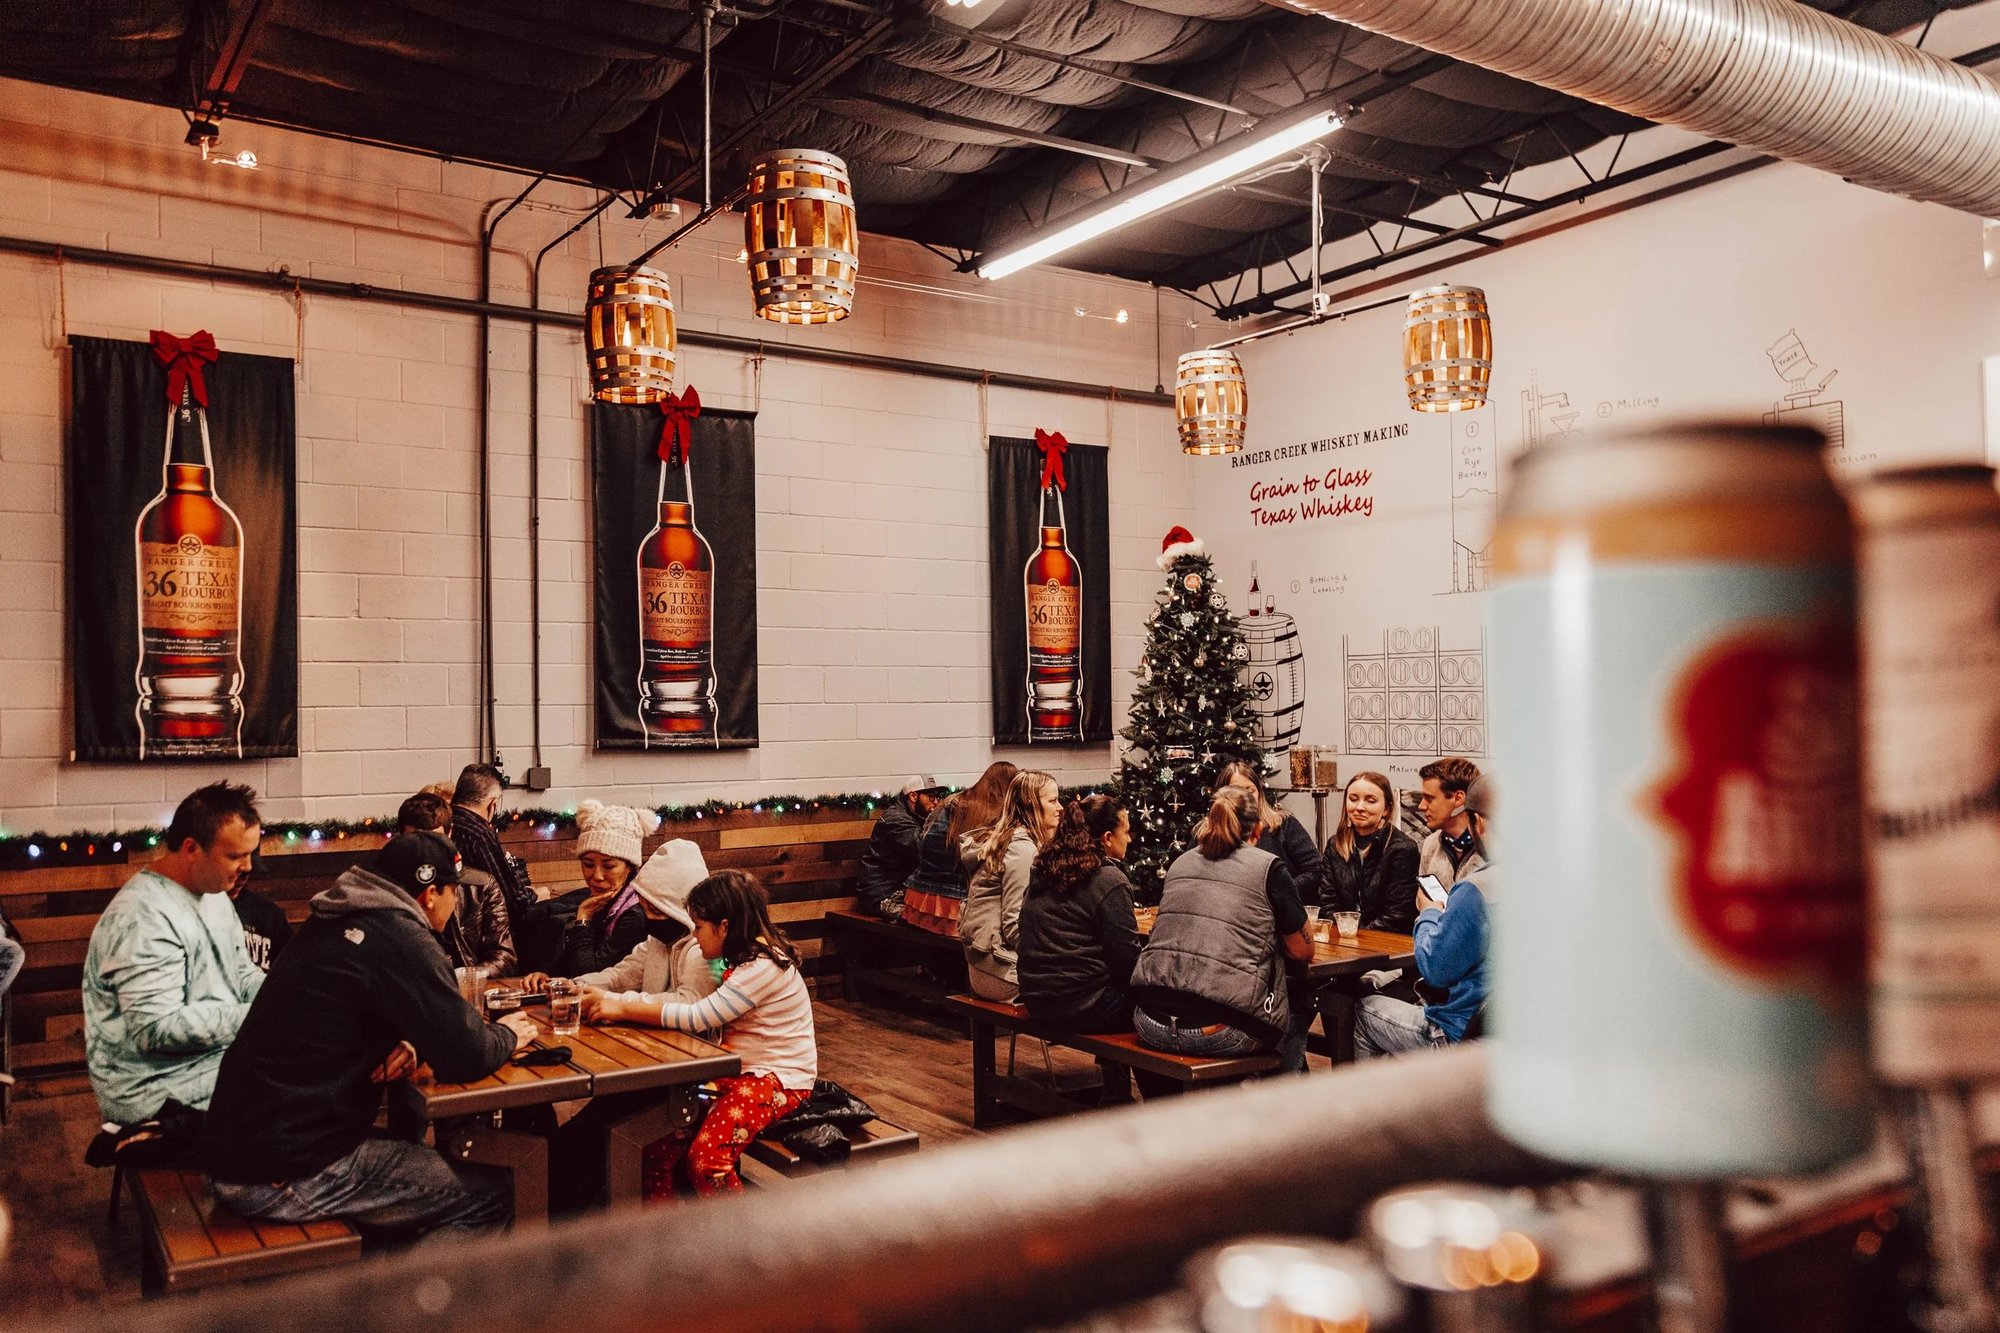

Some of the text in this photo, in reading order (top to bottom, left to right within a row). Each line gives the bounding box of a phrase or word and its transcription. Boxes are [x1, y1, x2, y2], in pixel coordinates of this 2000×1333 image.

[1231, 423, 1409, 468] RANGER CREEK WHISKEY MAKING
[1250, 467, 1373, 502] Grain to Glass
[1458, 469, 1488, 480] Barley
[1251, 494, 1373, 527] Texas Whiskey
[180, 571, 236, 587] TEXAS
[181, 587, 236, 599] BOURBON
